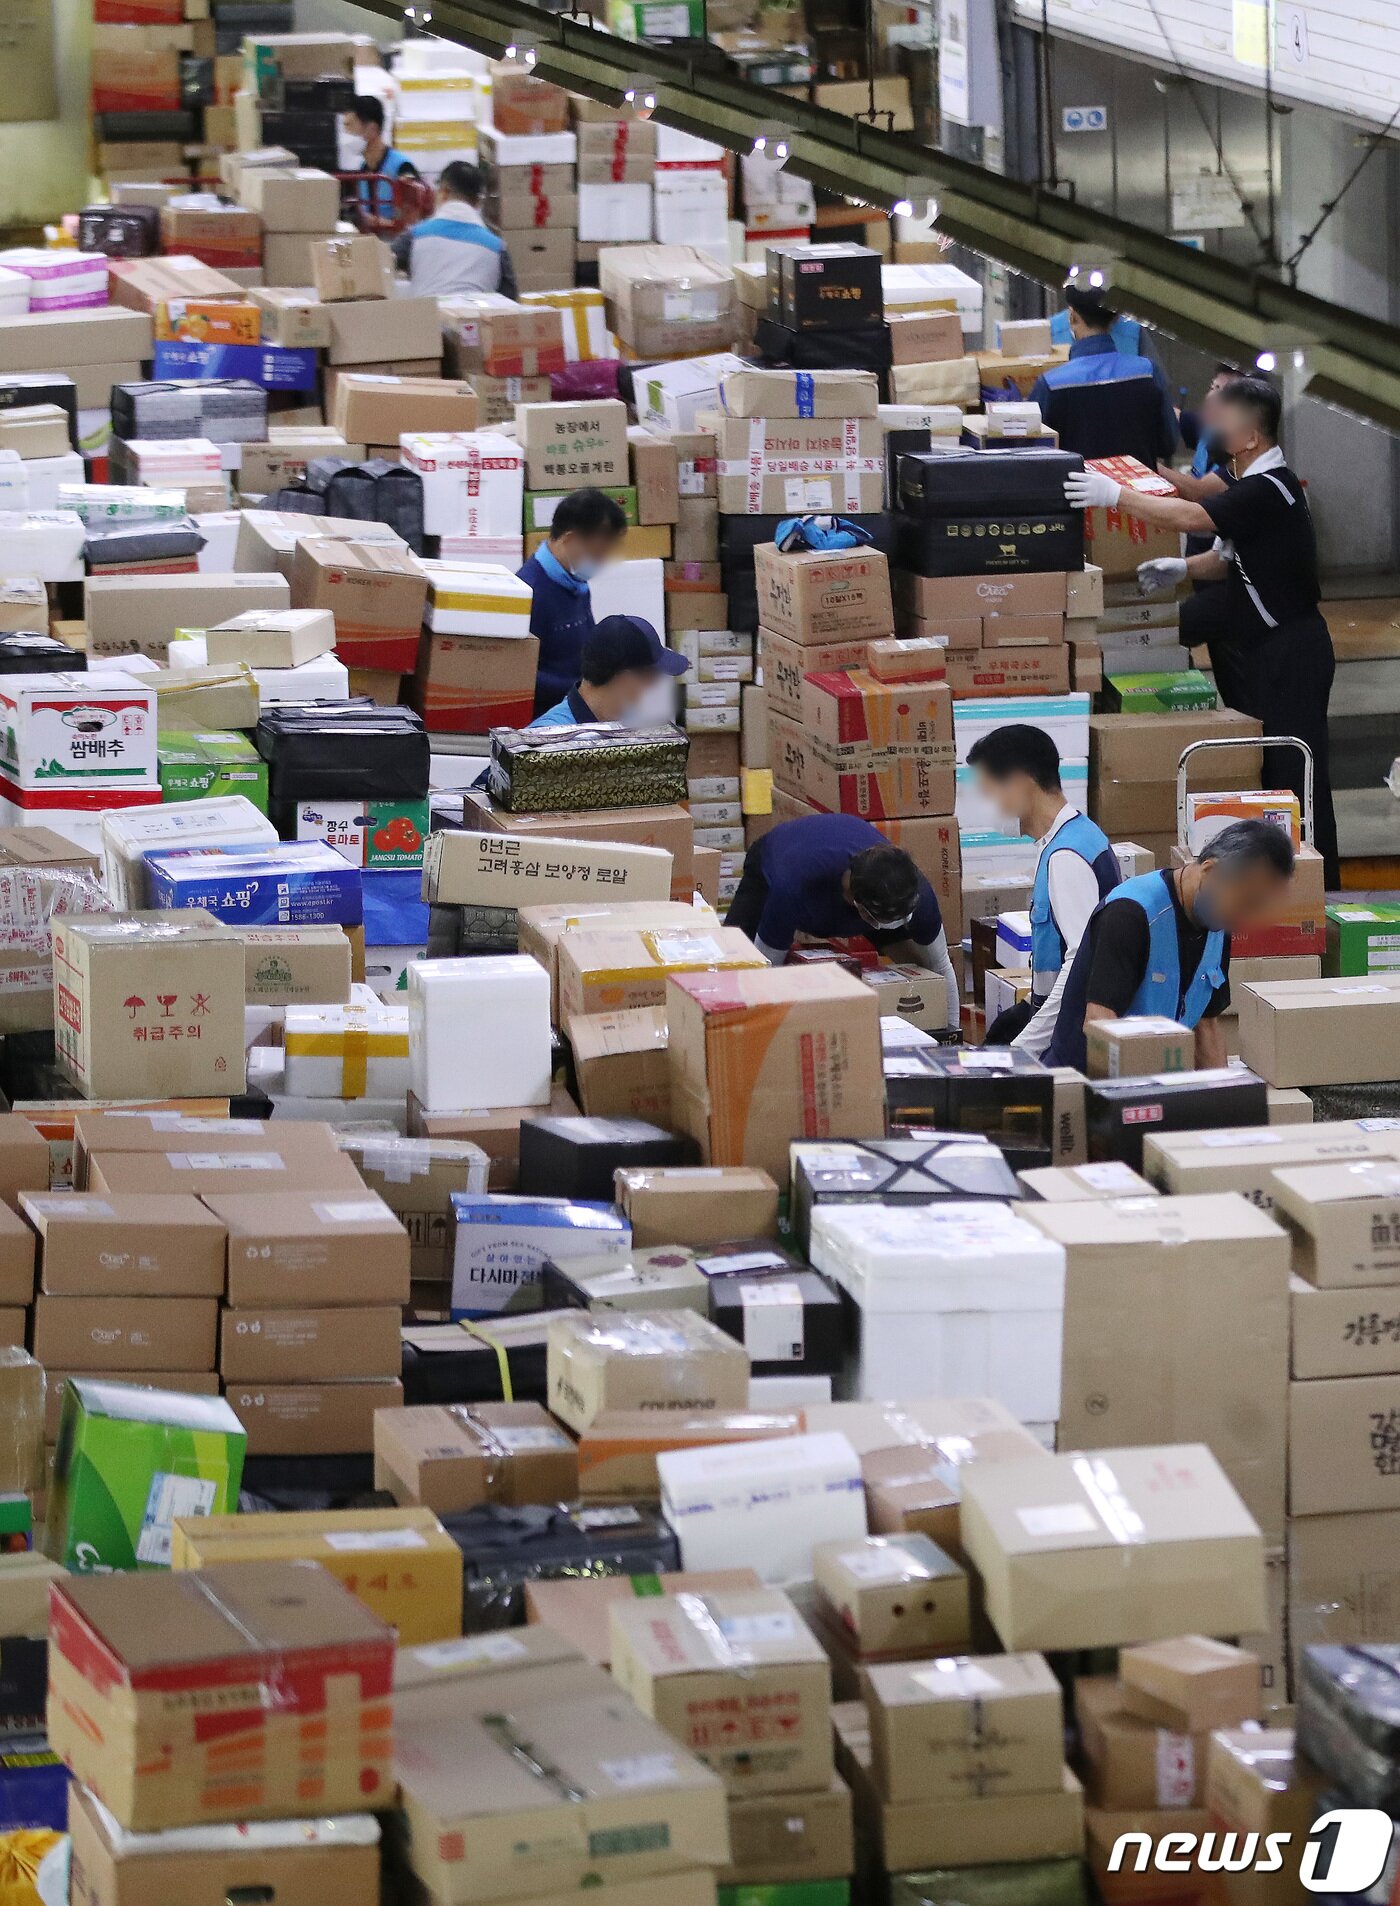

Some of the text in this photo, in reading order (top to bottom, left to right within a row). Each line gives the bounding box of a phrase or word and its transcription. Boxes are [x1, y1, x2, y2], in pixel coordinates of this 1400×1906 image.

[554, 421, 601, 435] 농장에서
[544, 461, 615, 476] 백봉오골계란
[70, 739, 126, 759] 쌈배추
[189, 777, 209, 789] 쇼핑
[326, 820, 349, 833] 장수
[326, 834, 360, 846] 토마토
[479, 838, 521, 856] 6년근
[370, 854, 395, 862] JANGSU
[477, 857, 628, 885] 고려홍삼 보양정 로얄
[185, 889, 251, 909] 우체국 쇼핑
[132, 1024, 202, 1042] 취급주의
